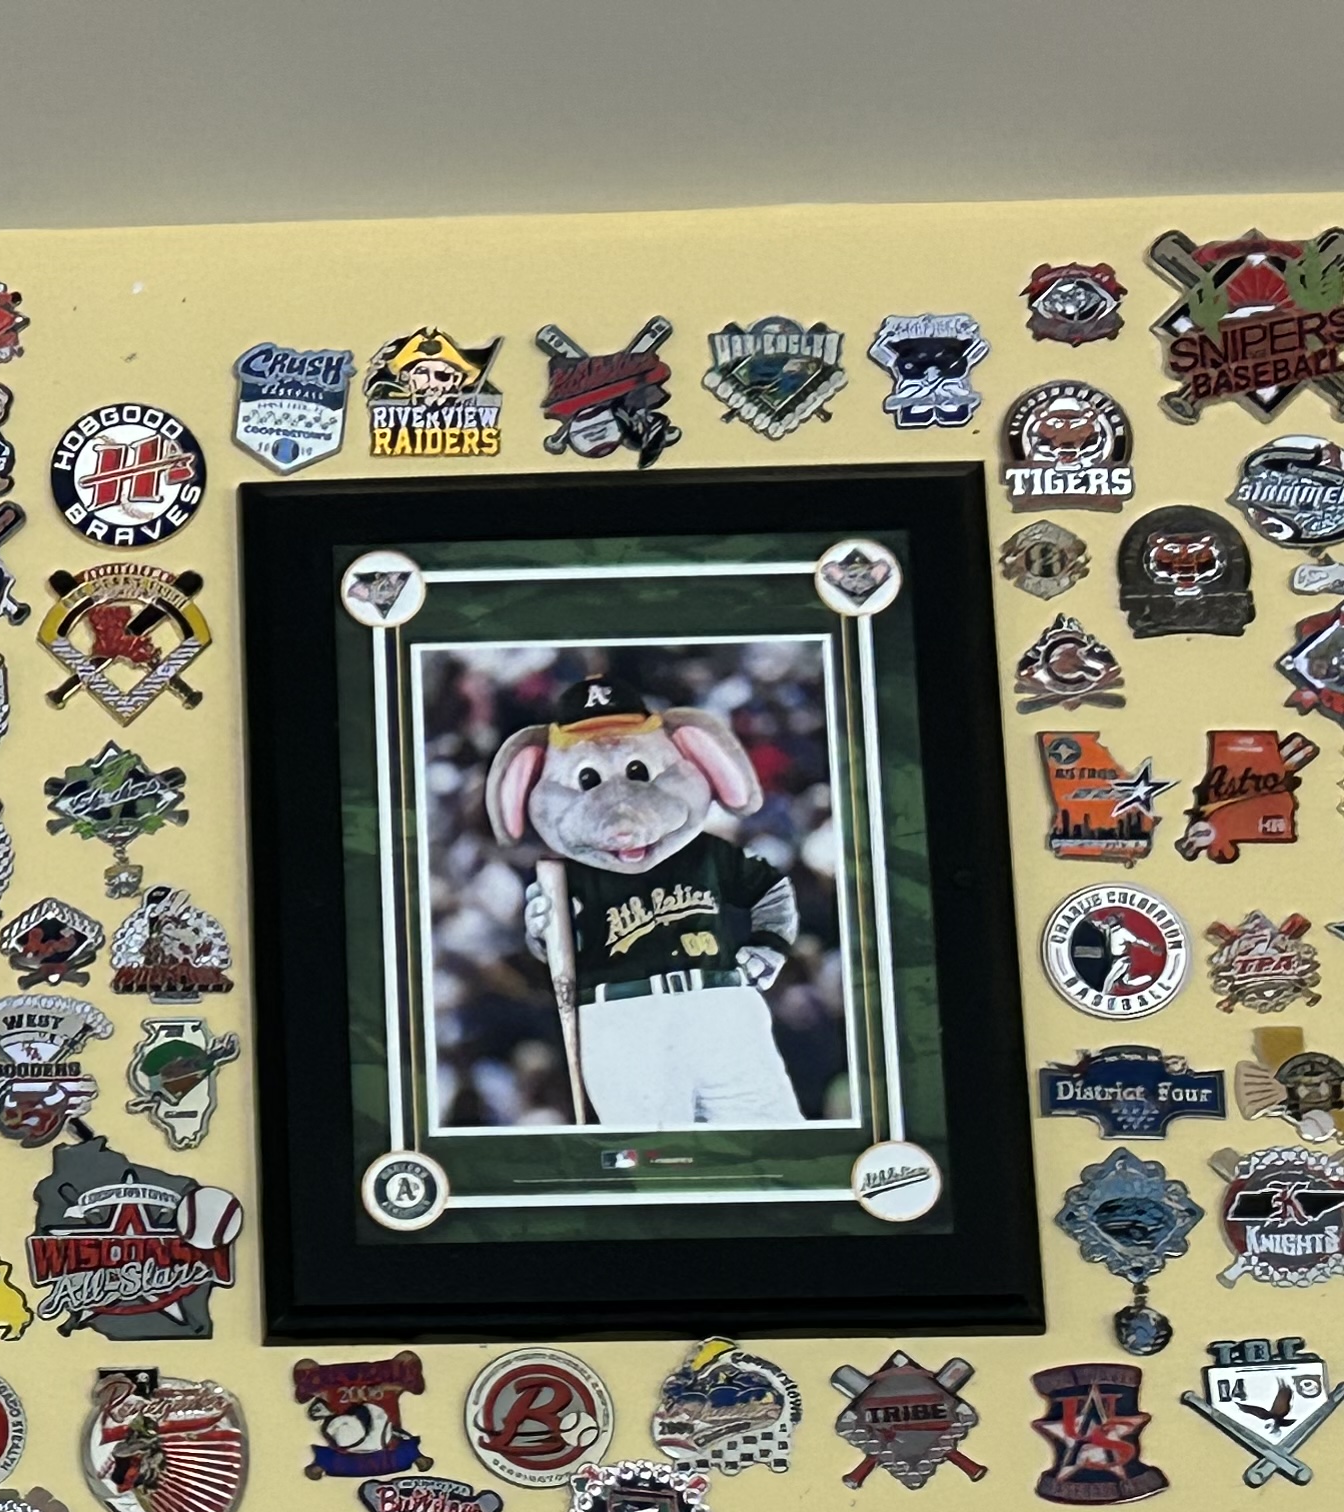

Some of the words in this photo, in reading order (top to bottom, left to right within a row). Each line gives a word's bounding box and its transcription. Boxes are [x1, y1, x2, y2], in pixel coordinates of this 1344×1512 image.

[1169, 307, 1344, 374] SNIPERS
[241, 348, 347, 389] CRUSH
[1191, 347, 1344, 399] BASEBALL
[52, 404, 185, 471] HOBGOOD
[372, 427, 501, 455] RAIDERS
[1005, 467, 1133, 497] TIGERS
[64, 482, 202, 546] BRAVES
[1064, 976, 1174, 1012] BASEBALL
[2, 1014, 65, 1030] WEST
[1055, 1080, 1146, 1102] District
[1158, 1083, 1213, 1103] Four
[1244, 1224, 1341, 1258] KNIGHTS
[864, 1404, 949, 1425] TRIBE
